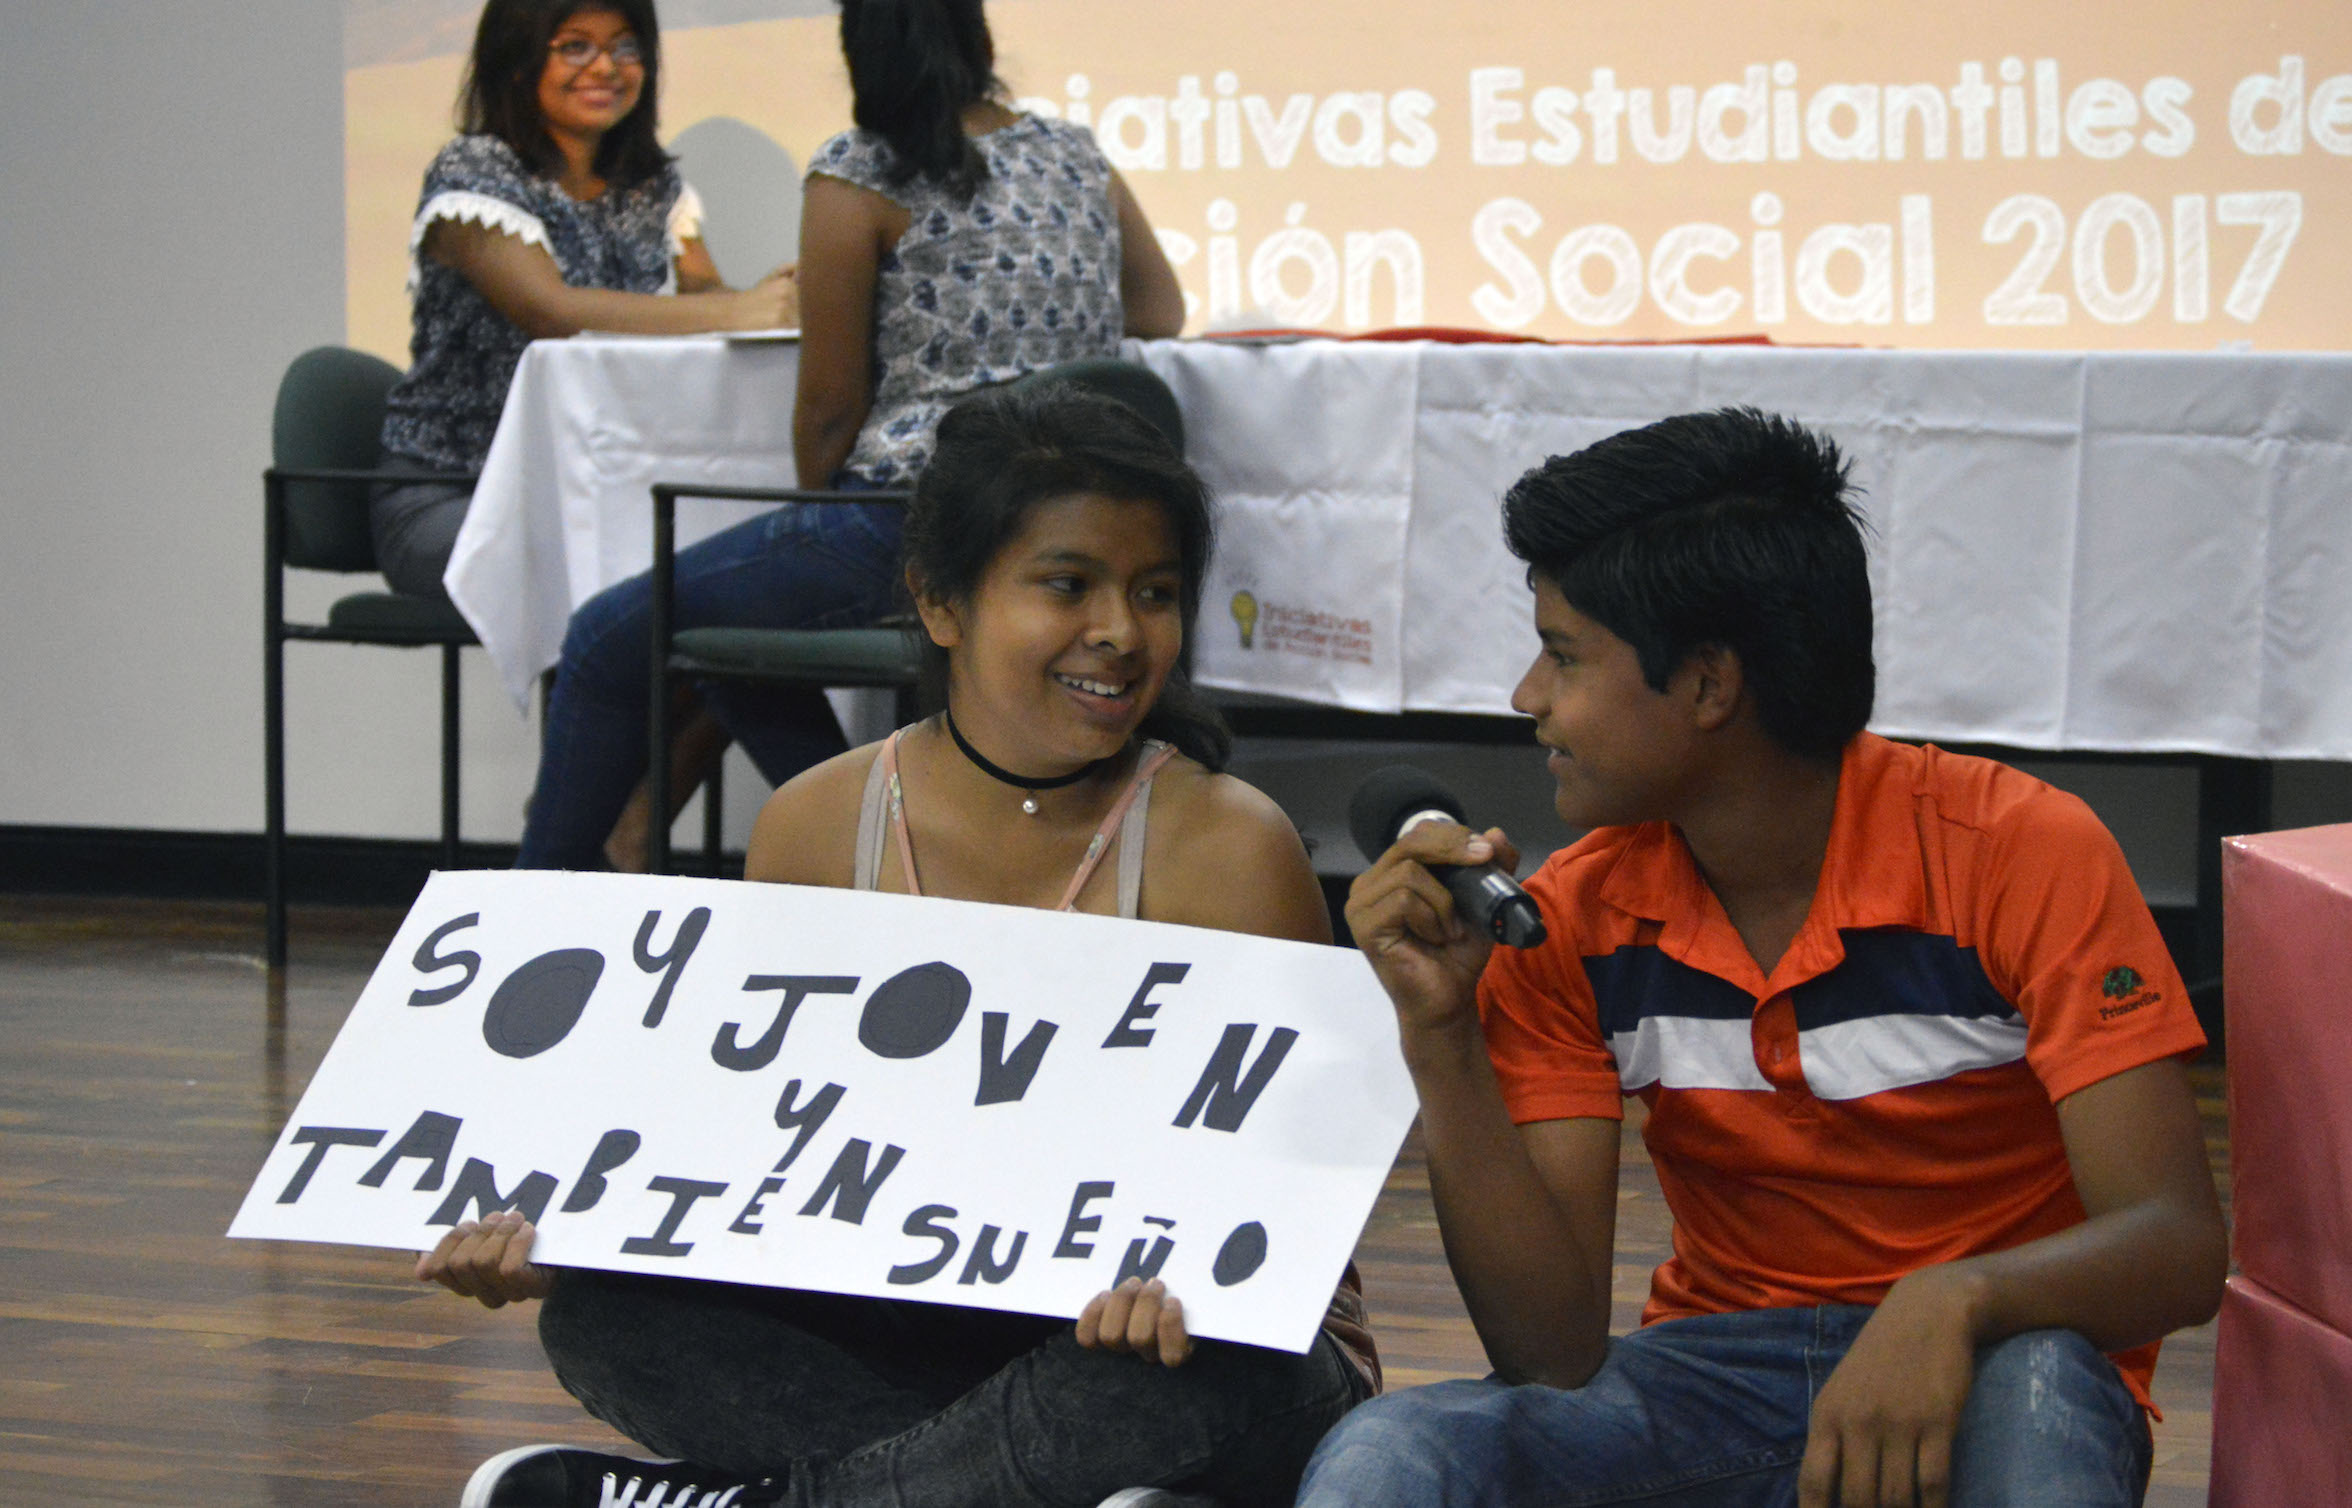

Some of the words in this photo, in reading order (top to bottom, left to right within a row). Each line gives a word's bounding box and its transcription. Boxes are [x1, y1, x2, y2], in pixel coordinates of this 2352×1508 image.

[1469, 56, 2197, 167] Estudiantiles
[1153, 197, 1425, 330] ión
[1469, 191, 1936, 331] Social
[1981, 190, 2304, 326] 2017
[408, 907, 711, 1058] SOY
[711, 961, 1299, 1132] JOVEN
[277, 1111, 905, 1256] TAMBIEN
